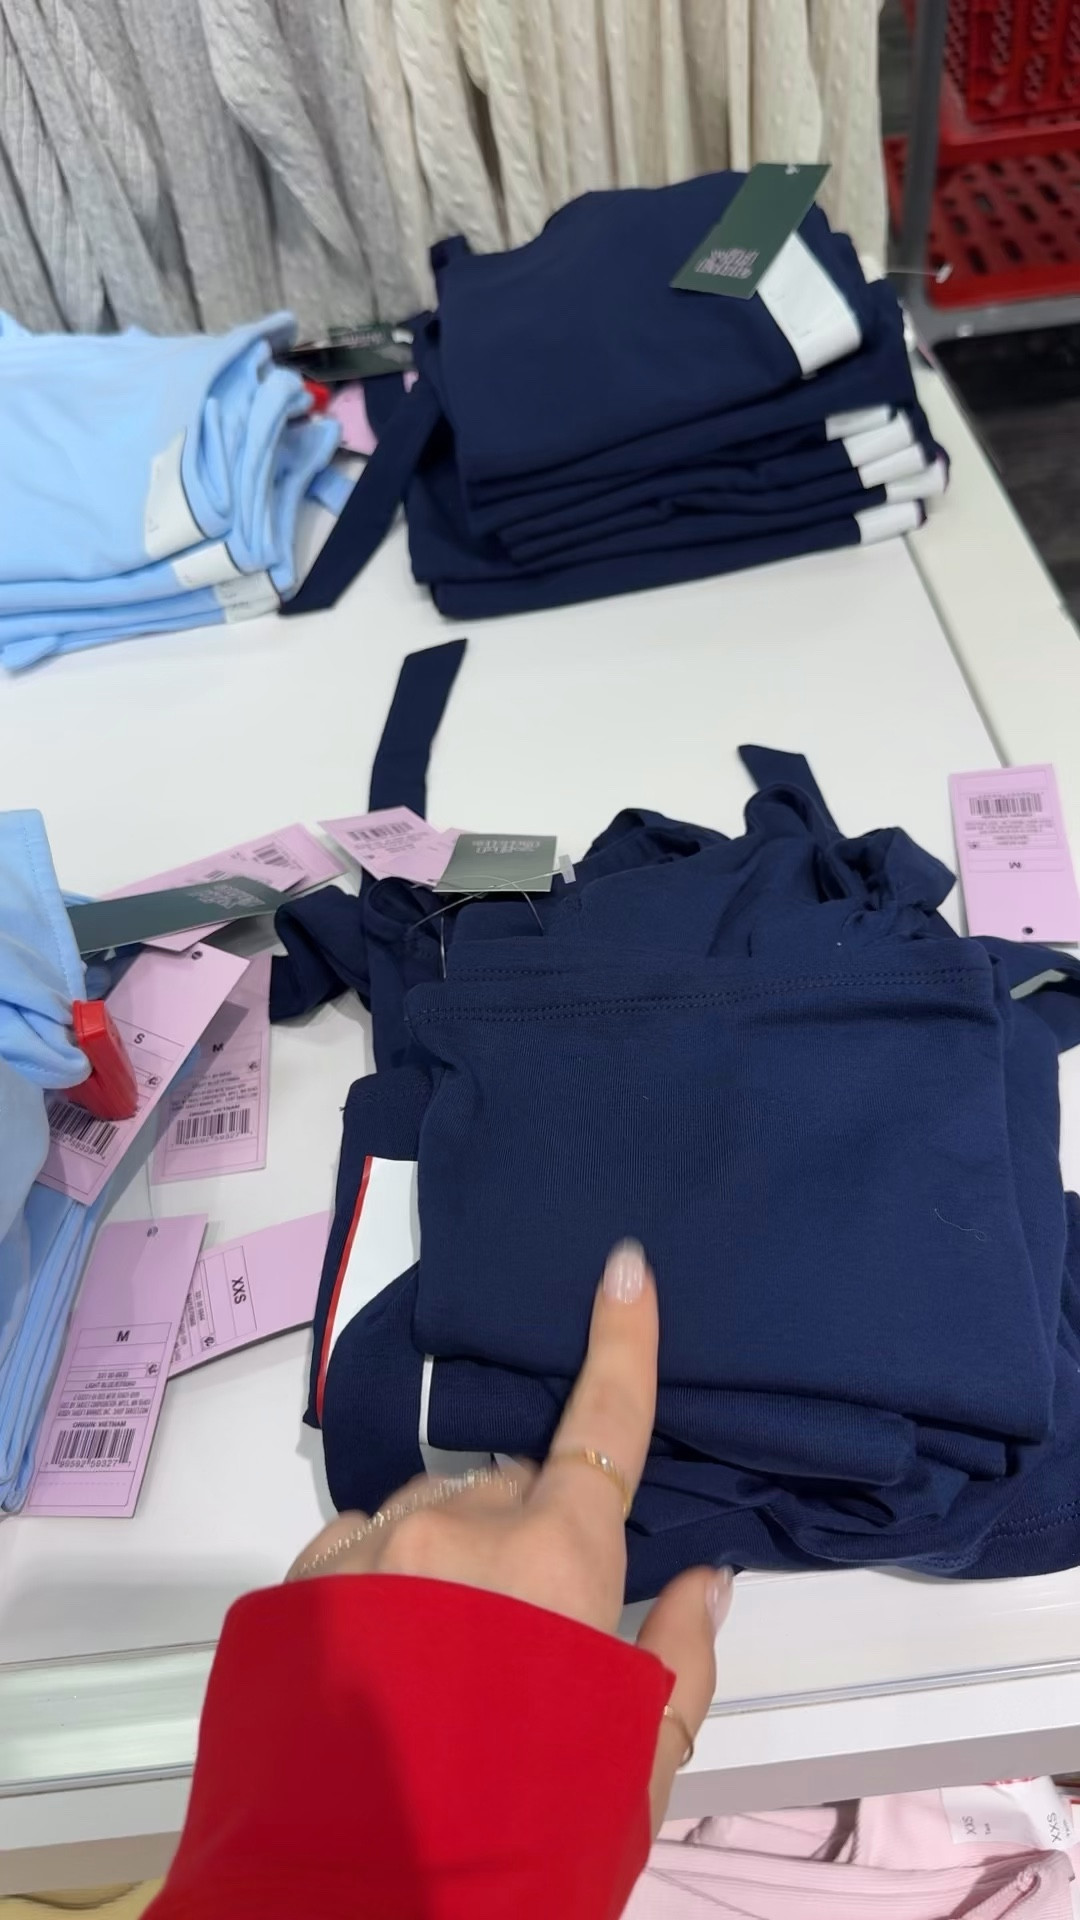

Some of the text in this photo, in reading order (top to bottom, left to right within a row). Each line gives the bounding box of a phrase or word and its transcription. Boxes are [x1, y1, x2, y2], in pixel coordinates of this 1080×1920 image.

[1009, 861, 1022, 869] M
[134, 1033, 145, 1044] S
[212, 1042, 224, 1053] M
[231, 1276, 247, 1305] XXS
[116, 1331, 130, 1342] M
[98, 1420, 127, 1428] VIETNAM
[90, 1459, 118, 1468] 59327
[962, 1816, 977, 1835] XXS
[1047, 1812, 1062, 1843] XXS
